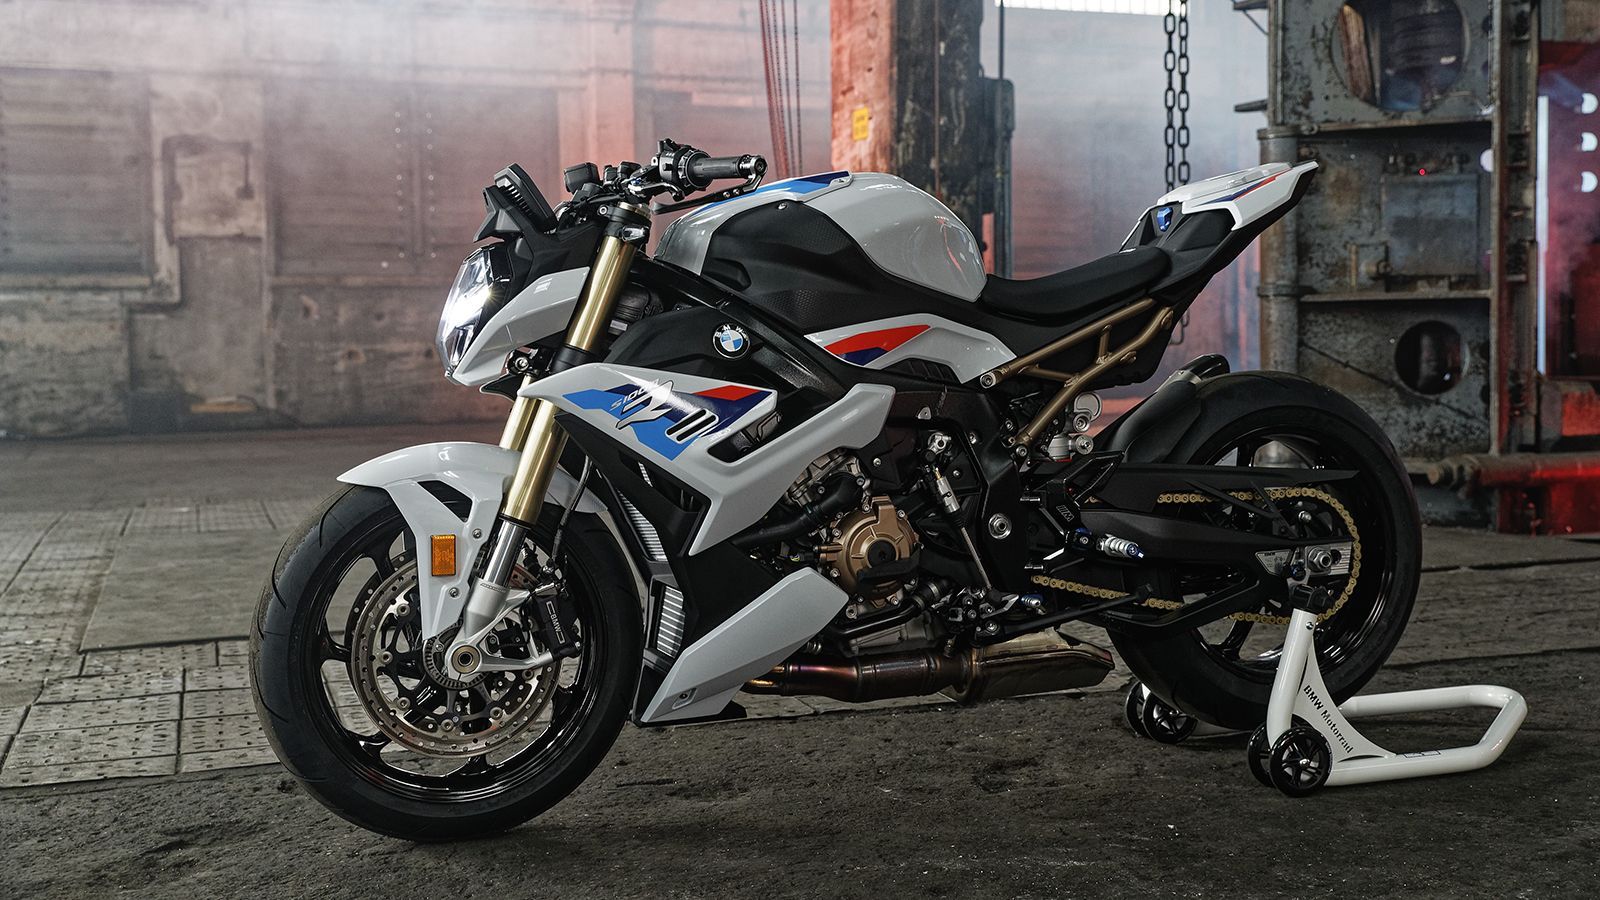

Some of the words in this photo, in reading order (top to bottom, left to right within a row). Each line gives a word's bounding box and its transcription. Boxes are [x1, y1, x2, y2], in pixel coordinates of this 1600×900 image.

[550, 613, 561, 632] BMW
[1303, 685, 1324, 710] BMW
[1320, 709, 1354, 753] Motorrad
